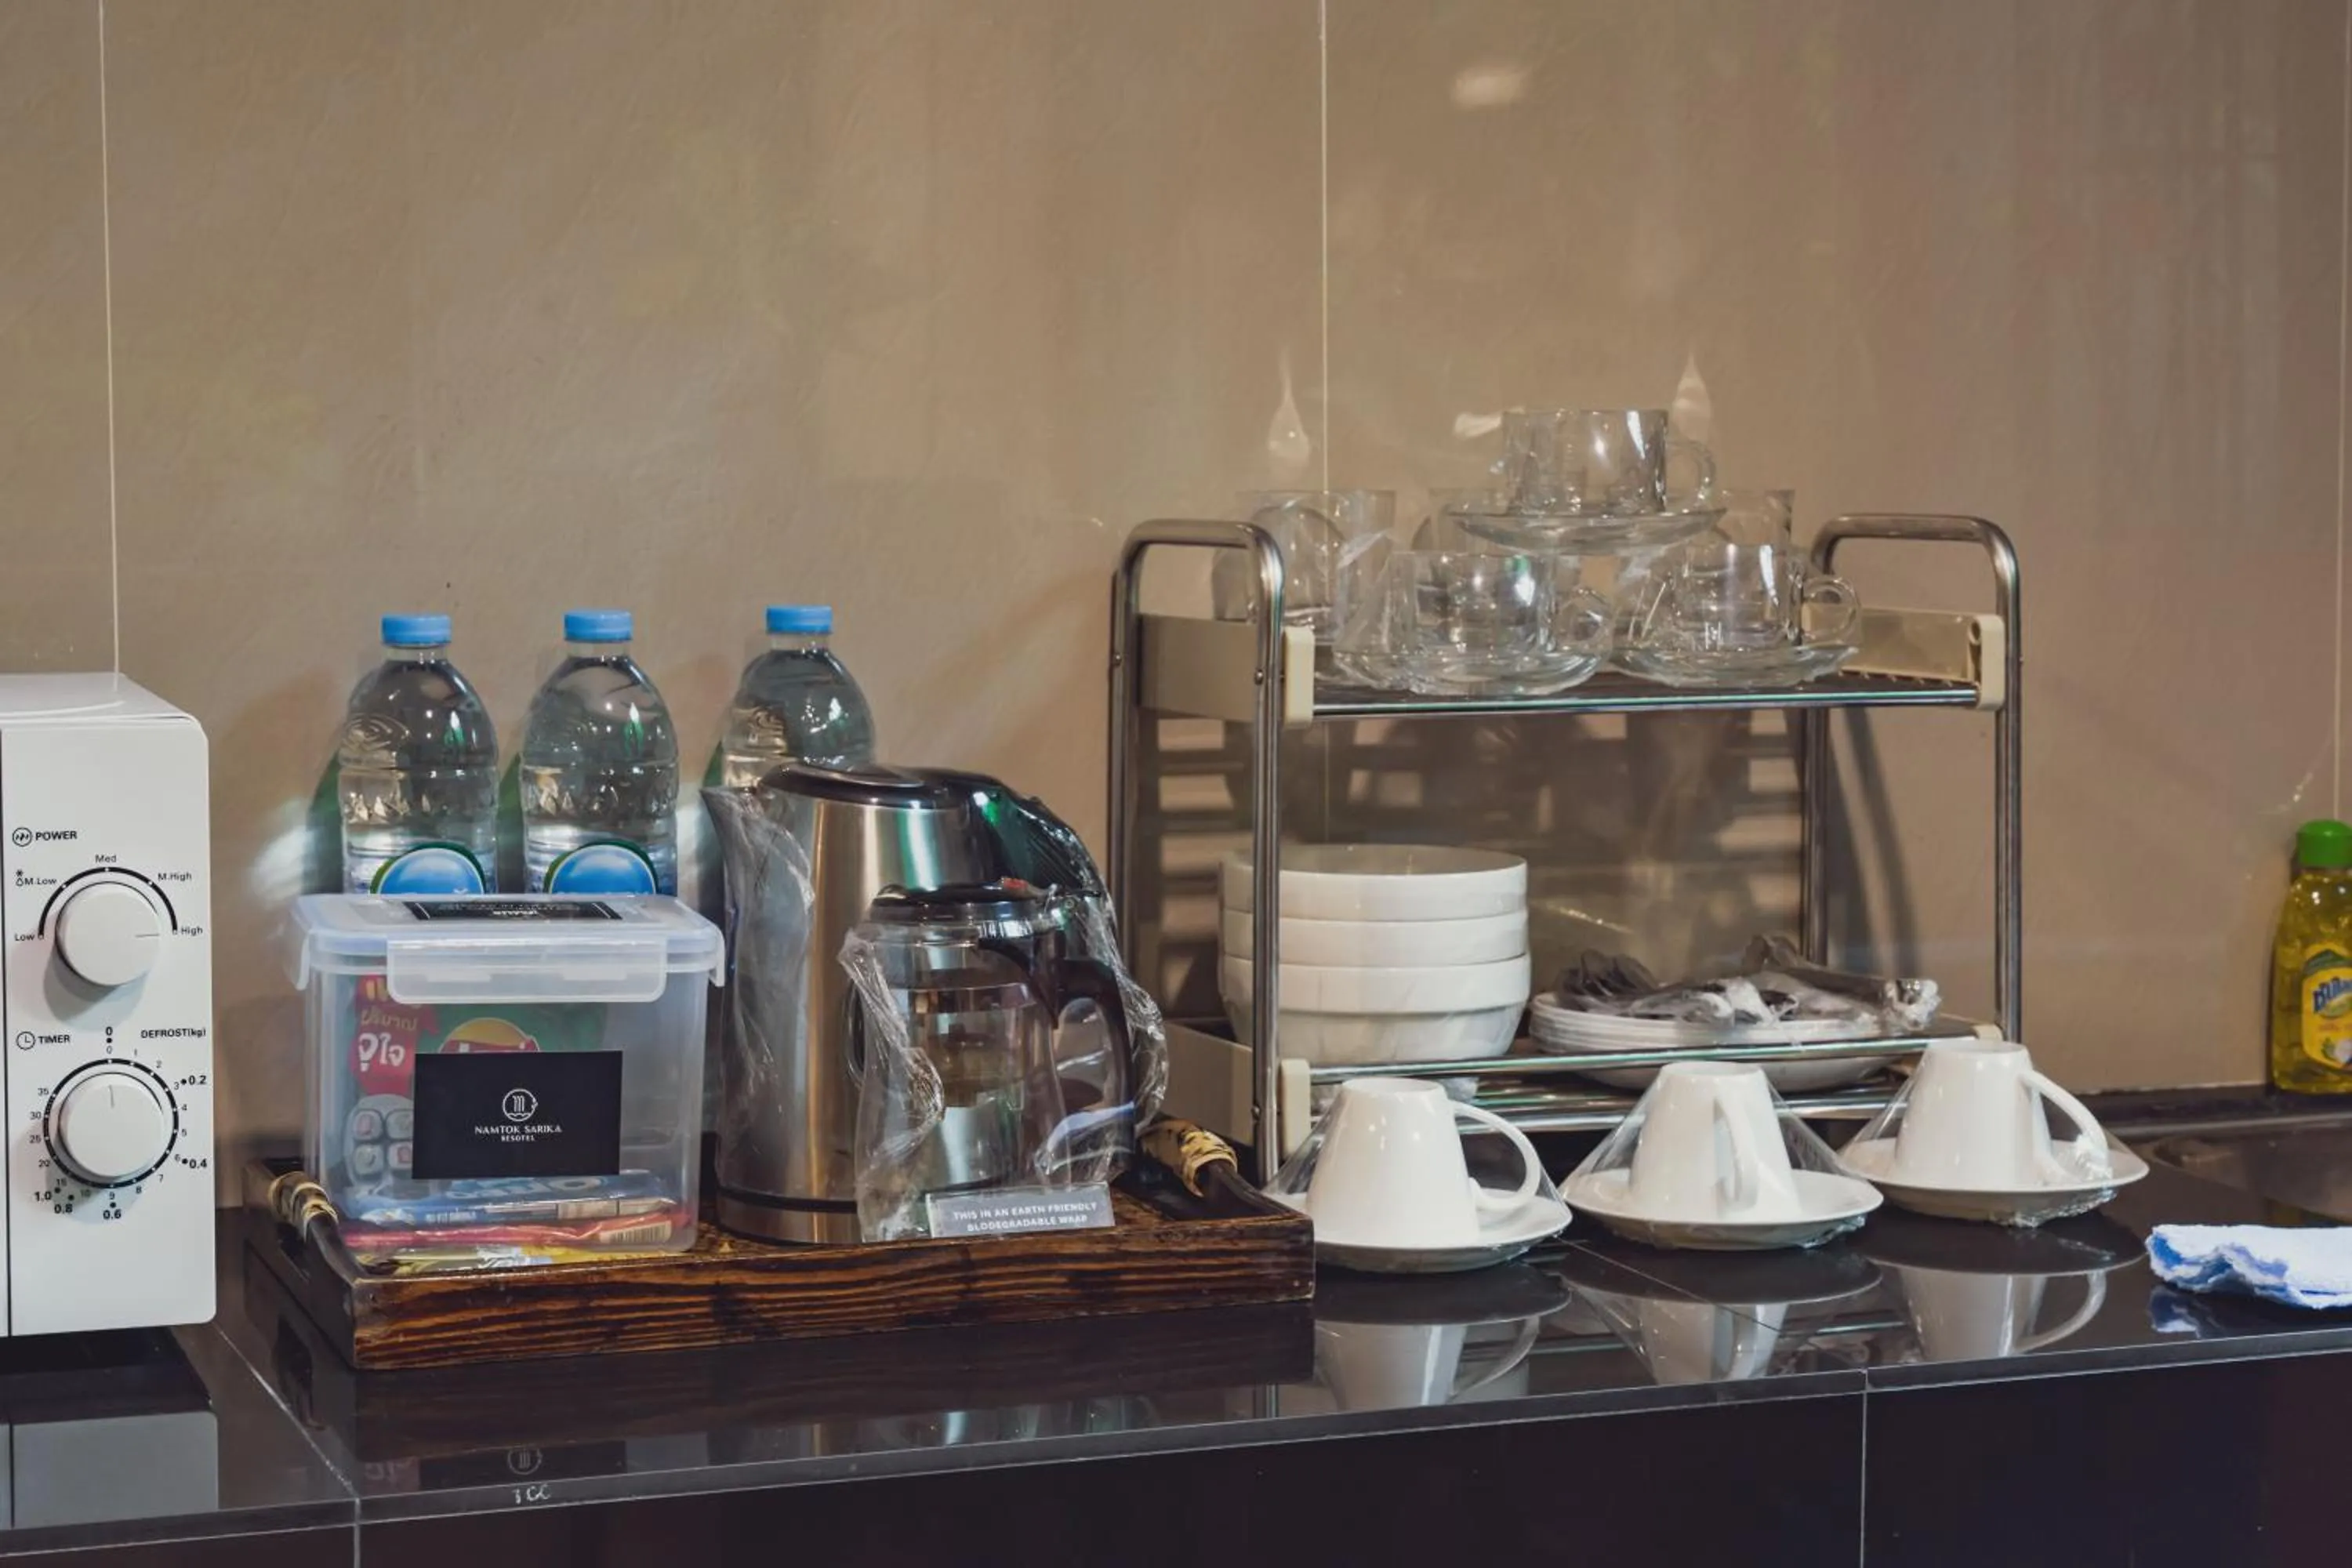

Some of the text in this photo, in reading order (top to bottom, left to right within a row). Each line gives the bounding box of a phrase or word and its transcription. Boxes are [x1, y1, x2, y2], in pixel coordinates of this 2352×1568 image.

[35, 831, 78, 841] POWER
[95, 855, 117, 863] Med
[158, 873, 192, 882] M.High
[181, 926, 203, 936] High
[105, 1026, 113, 1036] 0
[38, 1035, 71, 1045] TIMER
[188, 1075, 207, 1086] 0.2
[174, 1081, 180, 1091] 3
[474, 1124, 563, 1134] NAMTOK SARIKA
[189, 1158, 208, 1169] 0.4
[34, 1191, 52, 1202] 1.0
[54, 1203, 73, 1214] 0.8
[953, 1210, 978, 1221] THIS
[995, 1207, 1010, 1218] AN
[1011, 1204, 1046, 1217] EARTH
[1047, 1201, 1098, 1213] FRIENDLY
[103, 1209, 122, 1219] 0.6
[1058, 1214, 1087, 1224] WRAP
